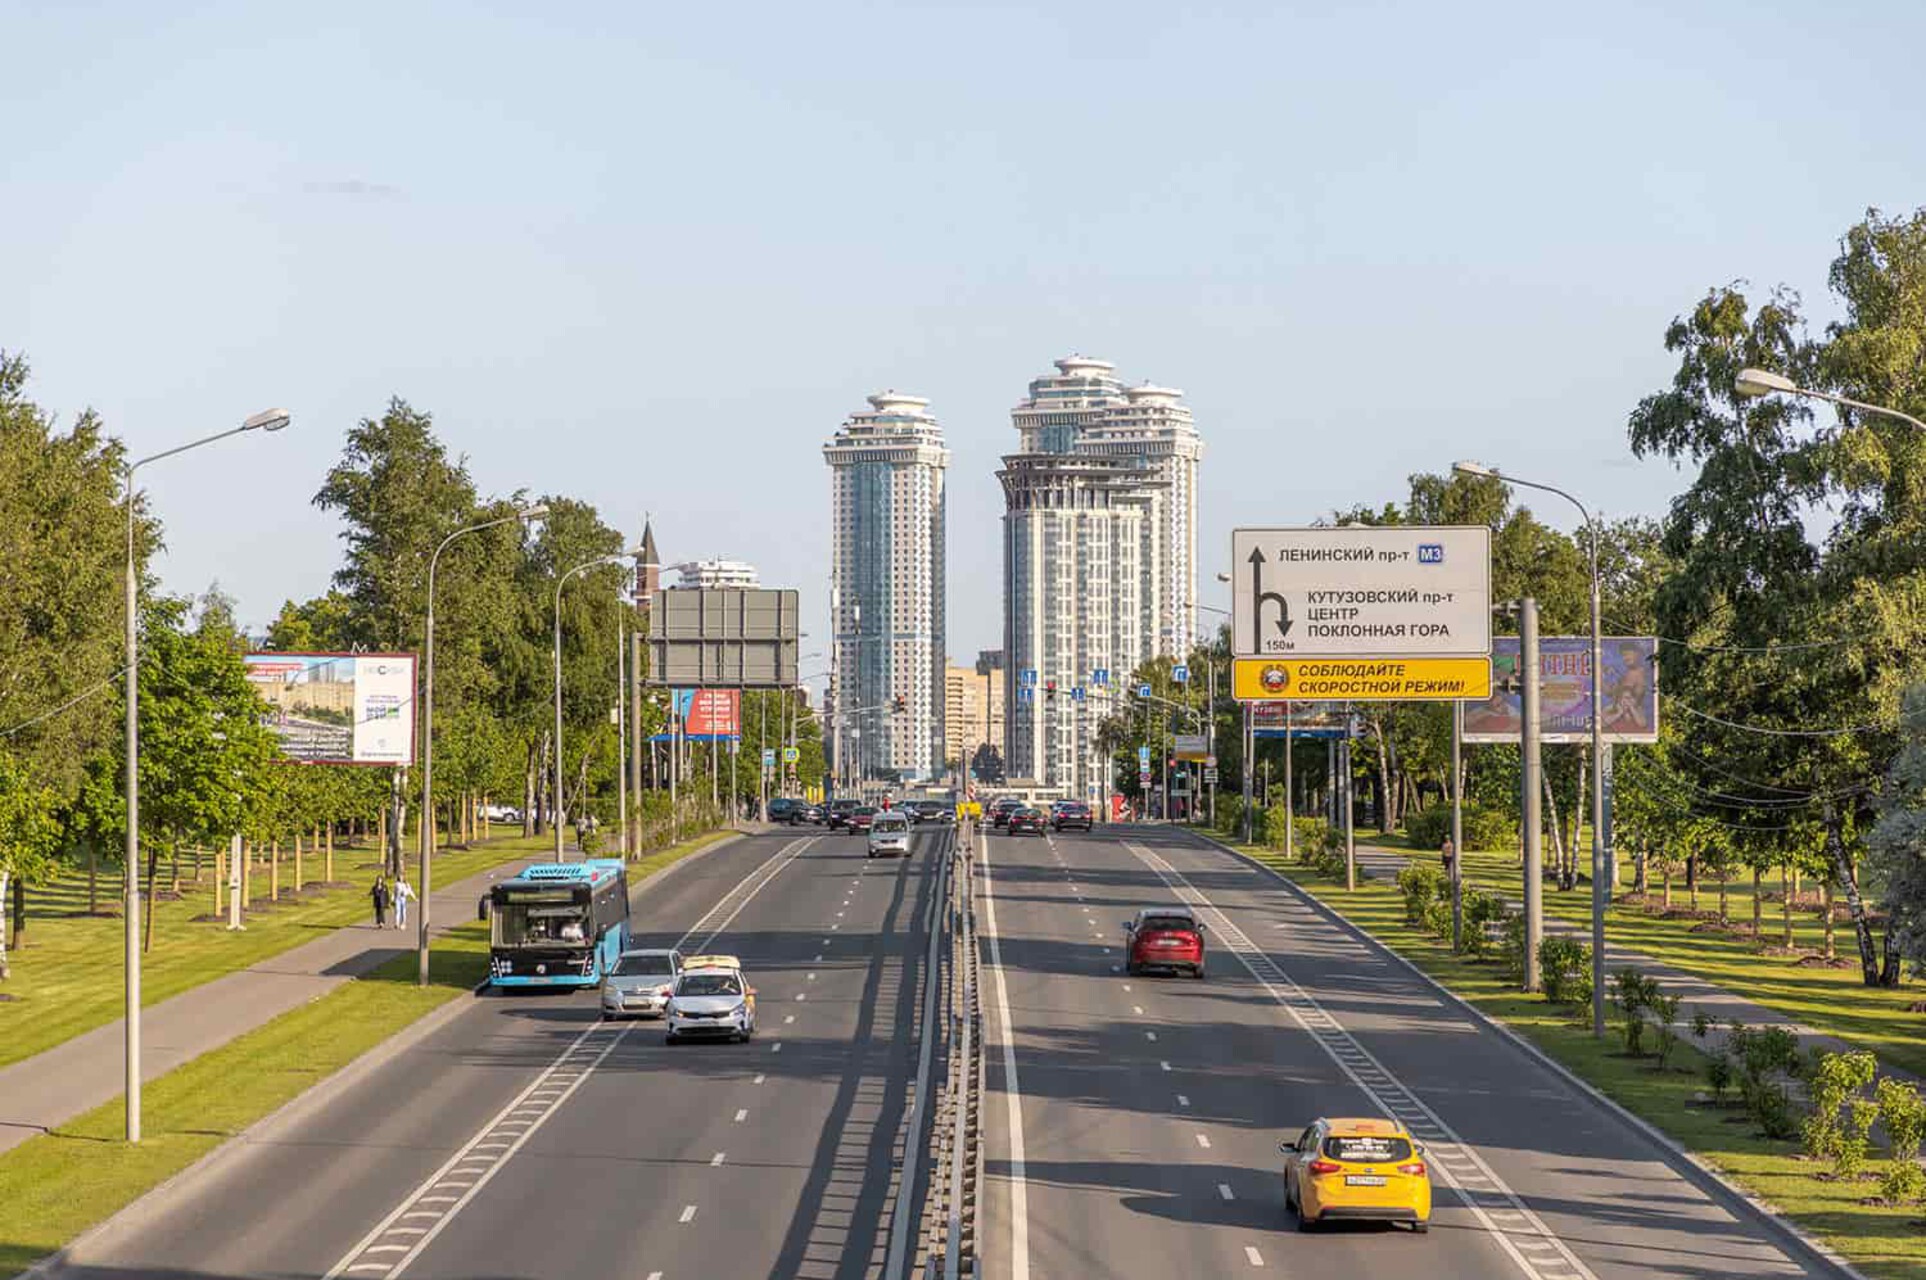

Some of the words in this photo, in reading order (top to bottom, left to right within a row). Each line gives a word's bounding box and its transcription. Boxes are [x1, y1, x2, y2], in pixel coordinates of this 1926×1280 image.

[1279, 546, 1374, 561] ЛЕНИНСКИЙ
[1378, 551, 1410, 563] пр-т
[1307, 588, 1418, 603] КУТУЗОВСКИЙ
[1422, 593, 1453, 606] пр-т
[1308, 608, 1359, 621] ЦЕНТР
[1308, 625, 1405, 637] ПОКЛОННАЯ
[1410, 624, 1449, 637] ГОРА
[1266, 640, 1294, 650] 150м
[1299, 663, 1406, 678] СОБЛЮДАЙТЕ
[1404, 680, 1465, 693] РЕЖИМ!
